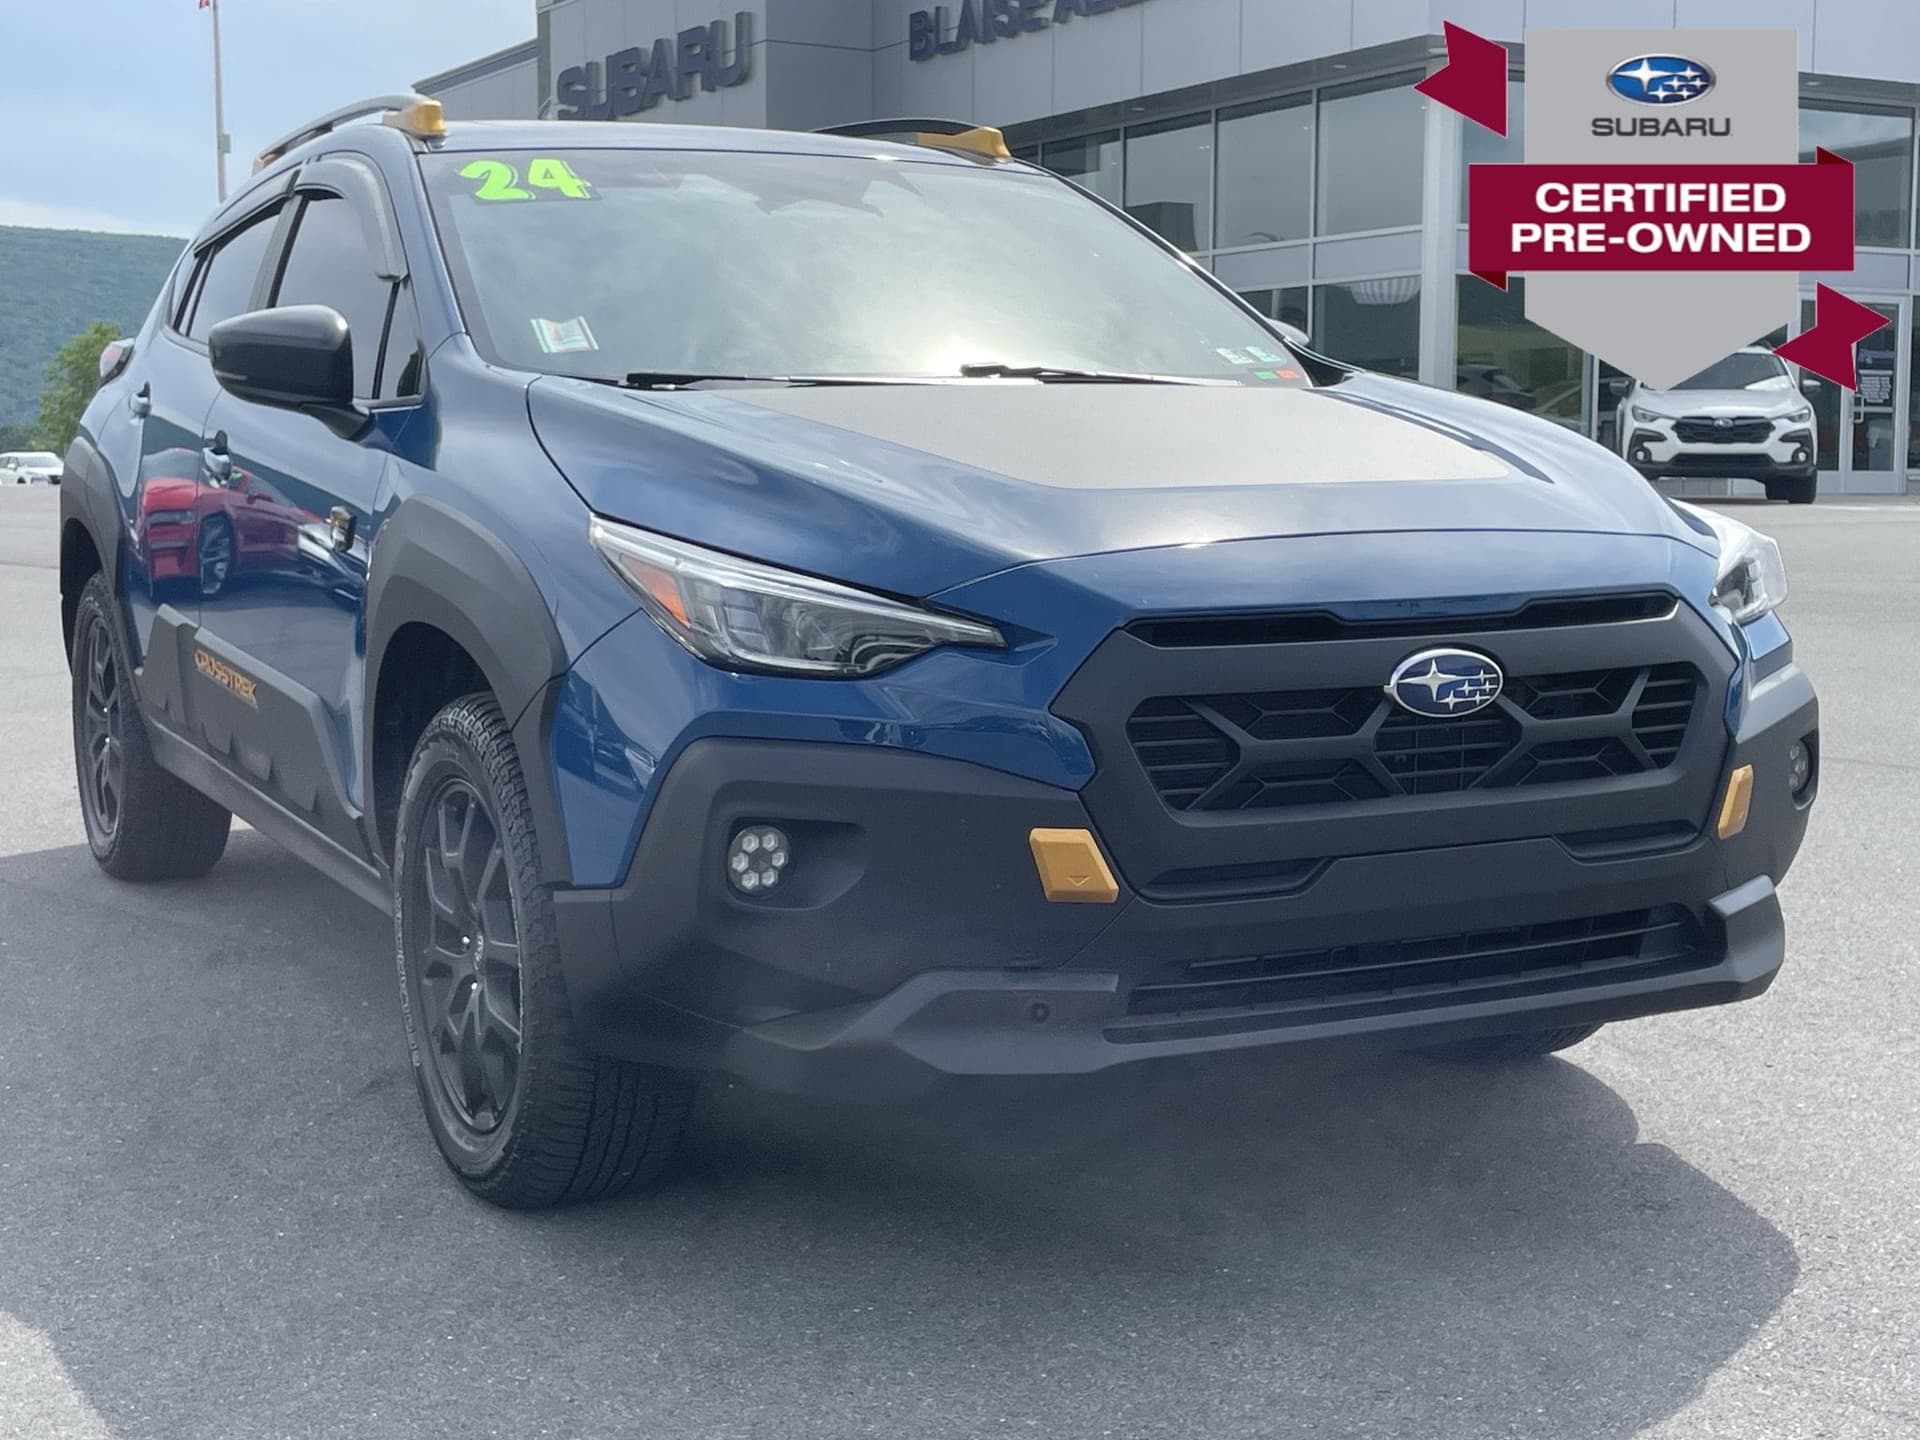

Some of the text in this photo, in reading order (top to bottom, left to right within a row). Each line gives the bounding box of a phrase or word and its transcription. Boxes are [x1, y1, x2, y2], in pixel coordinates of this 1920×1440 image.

[908, 0, 1050, 62] BLAISE
[557, 11, 752, 121] SUBARU
[459, 158, 592, 200] 24
[194, 648, 257, 706] CROSSTREK
